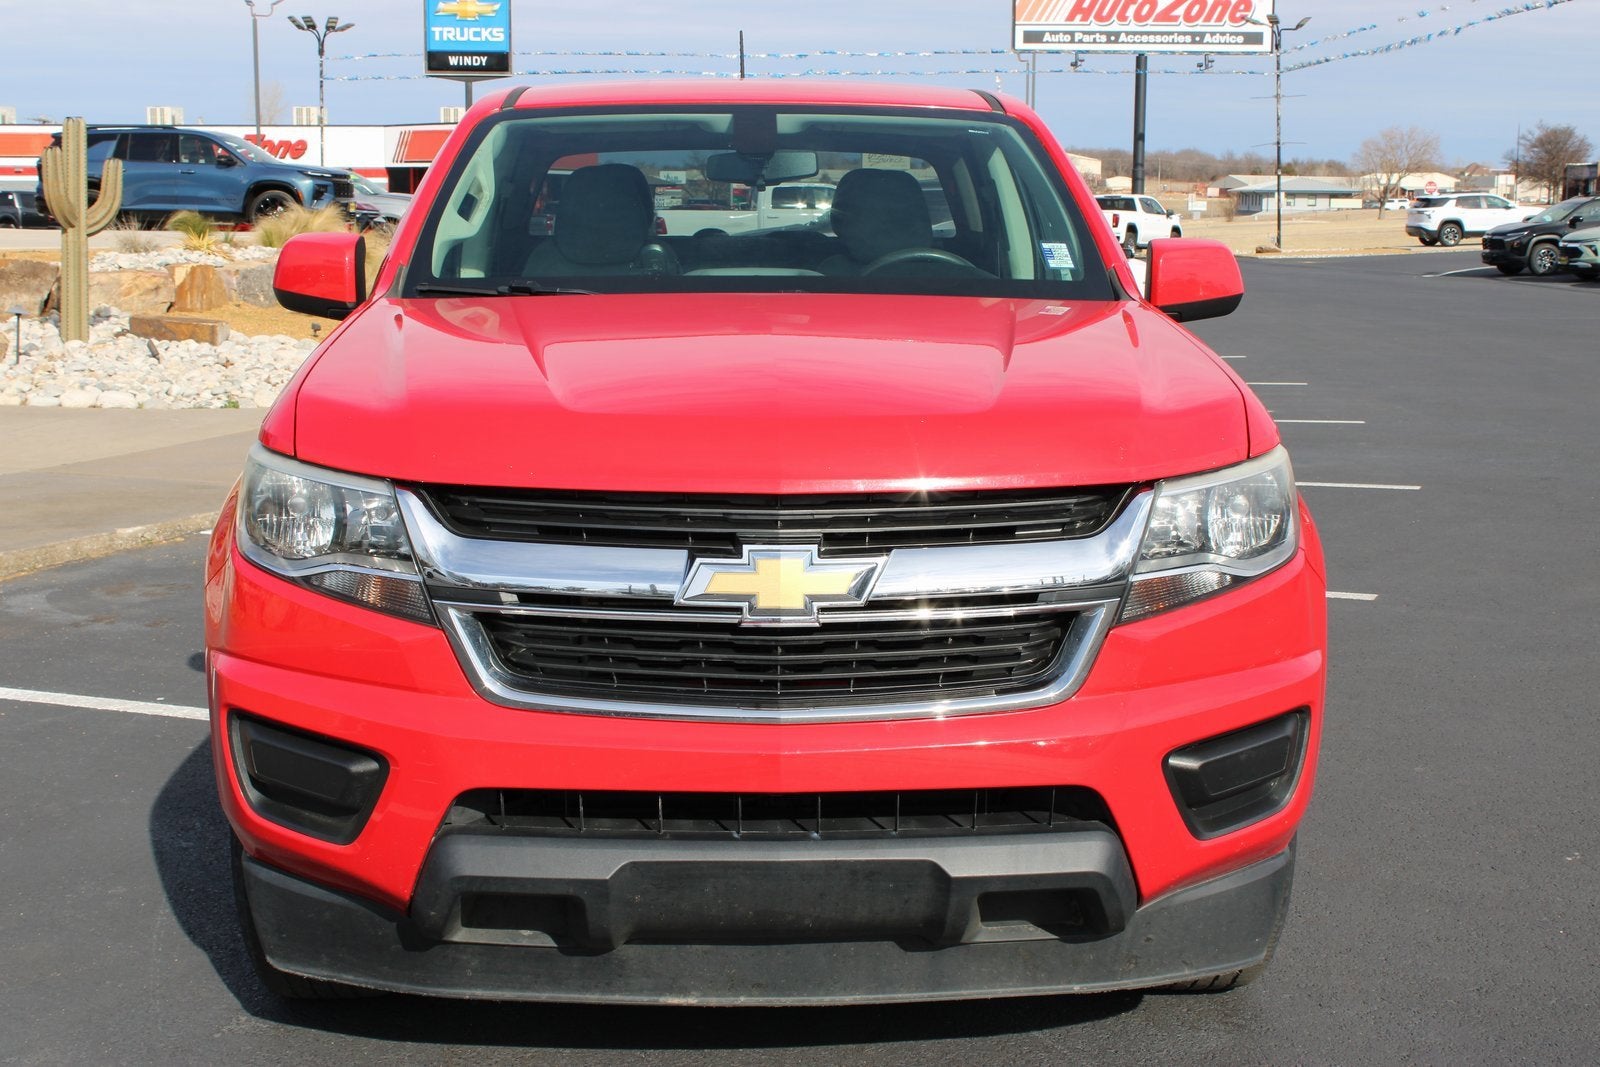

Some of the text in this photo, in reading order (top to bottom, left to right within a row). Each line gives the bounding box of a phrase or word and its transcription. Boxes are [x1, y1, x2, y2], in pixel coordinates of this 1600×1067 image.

[1064, 0, 1254, 24] AutoZone
[431, 27, 505, 42] TRUCKS
[1042, 31, 1245, 44] Auto Parts Accessories Advice
[448, 55, 488, 66] WINDY
